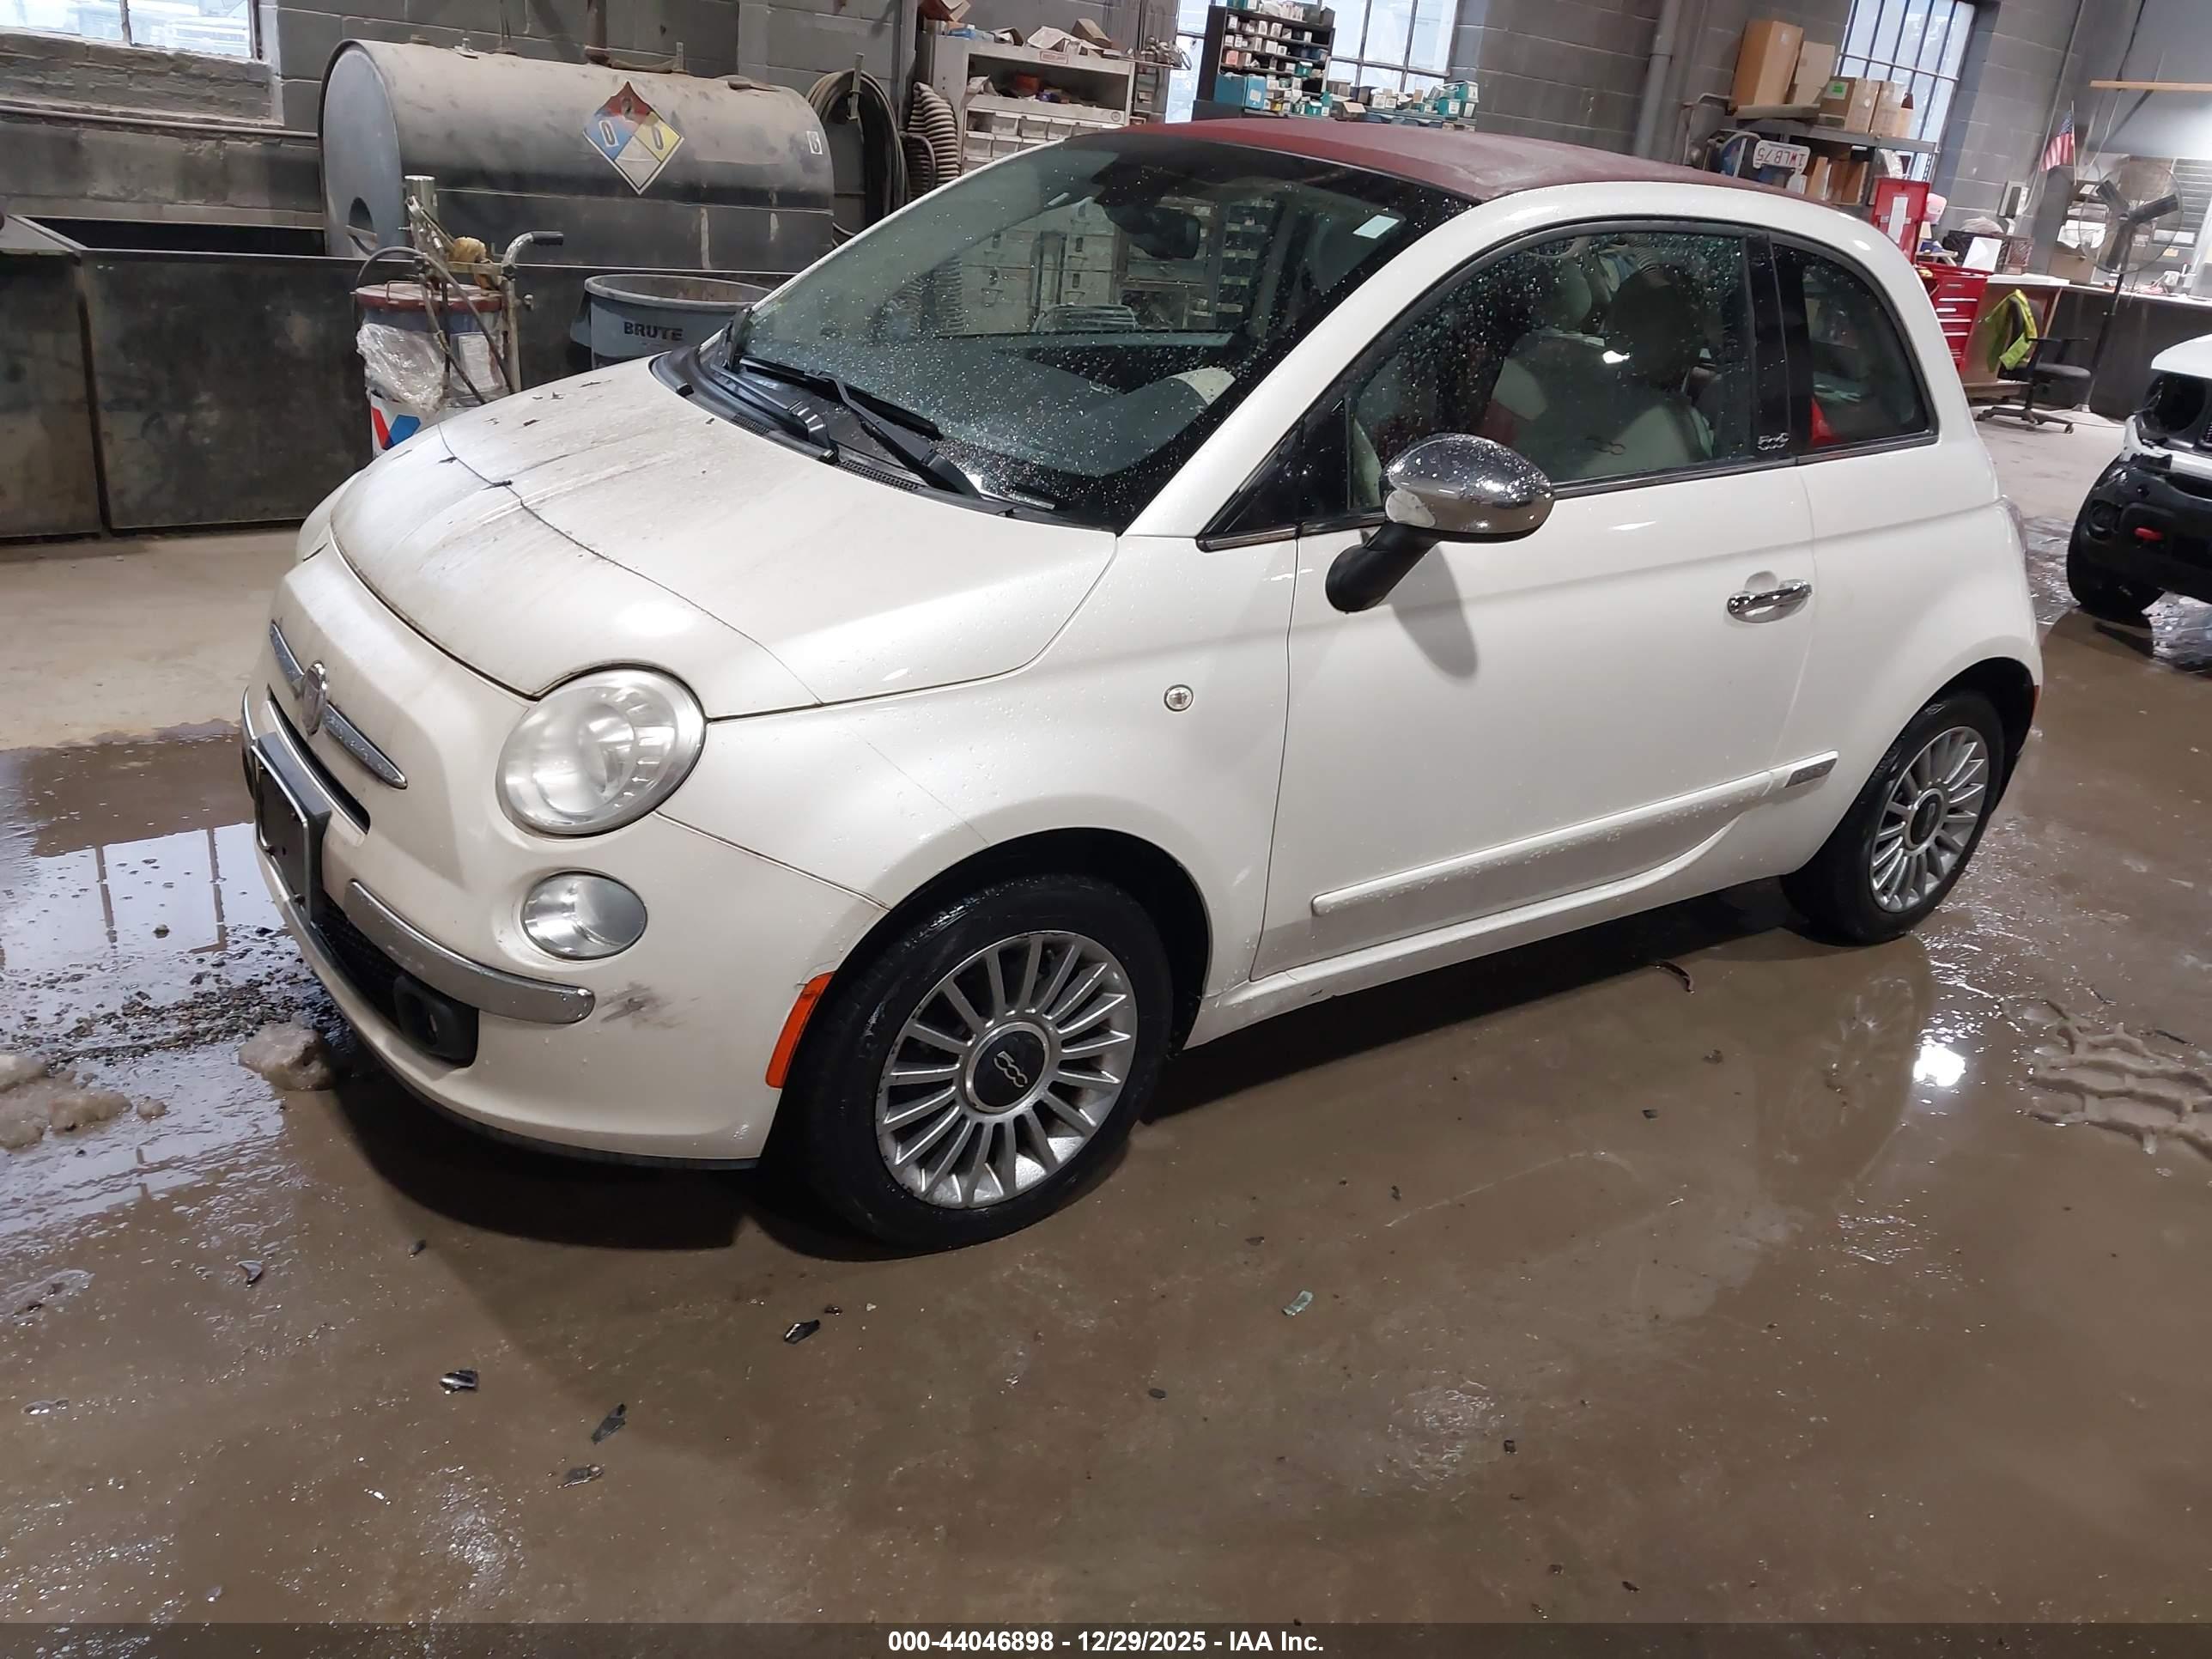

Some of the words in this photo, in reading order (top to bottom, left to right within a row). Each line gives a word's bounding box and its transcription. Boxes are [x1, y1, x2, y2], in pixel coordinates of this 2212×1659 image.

[601, 121, 616, 146] 0
[652, 126, 664, 150] 0
[624, 321, 684, 341] BRUTE
[994, 1050, 1028, 1088] 500
